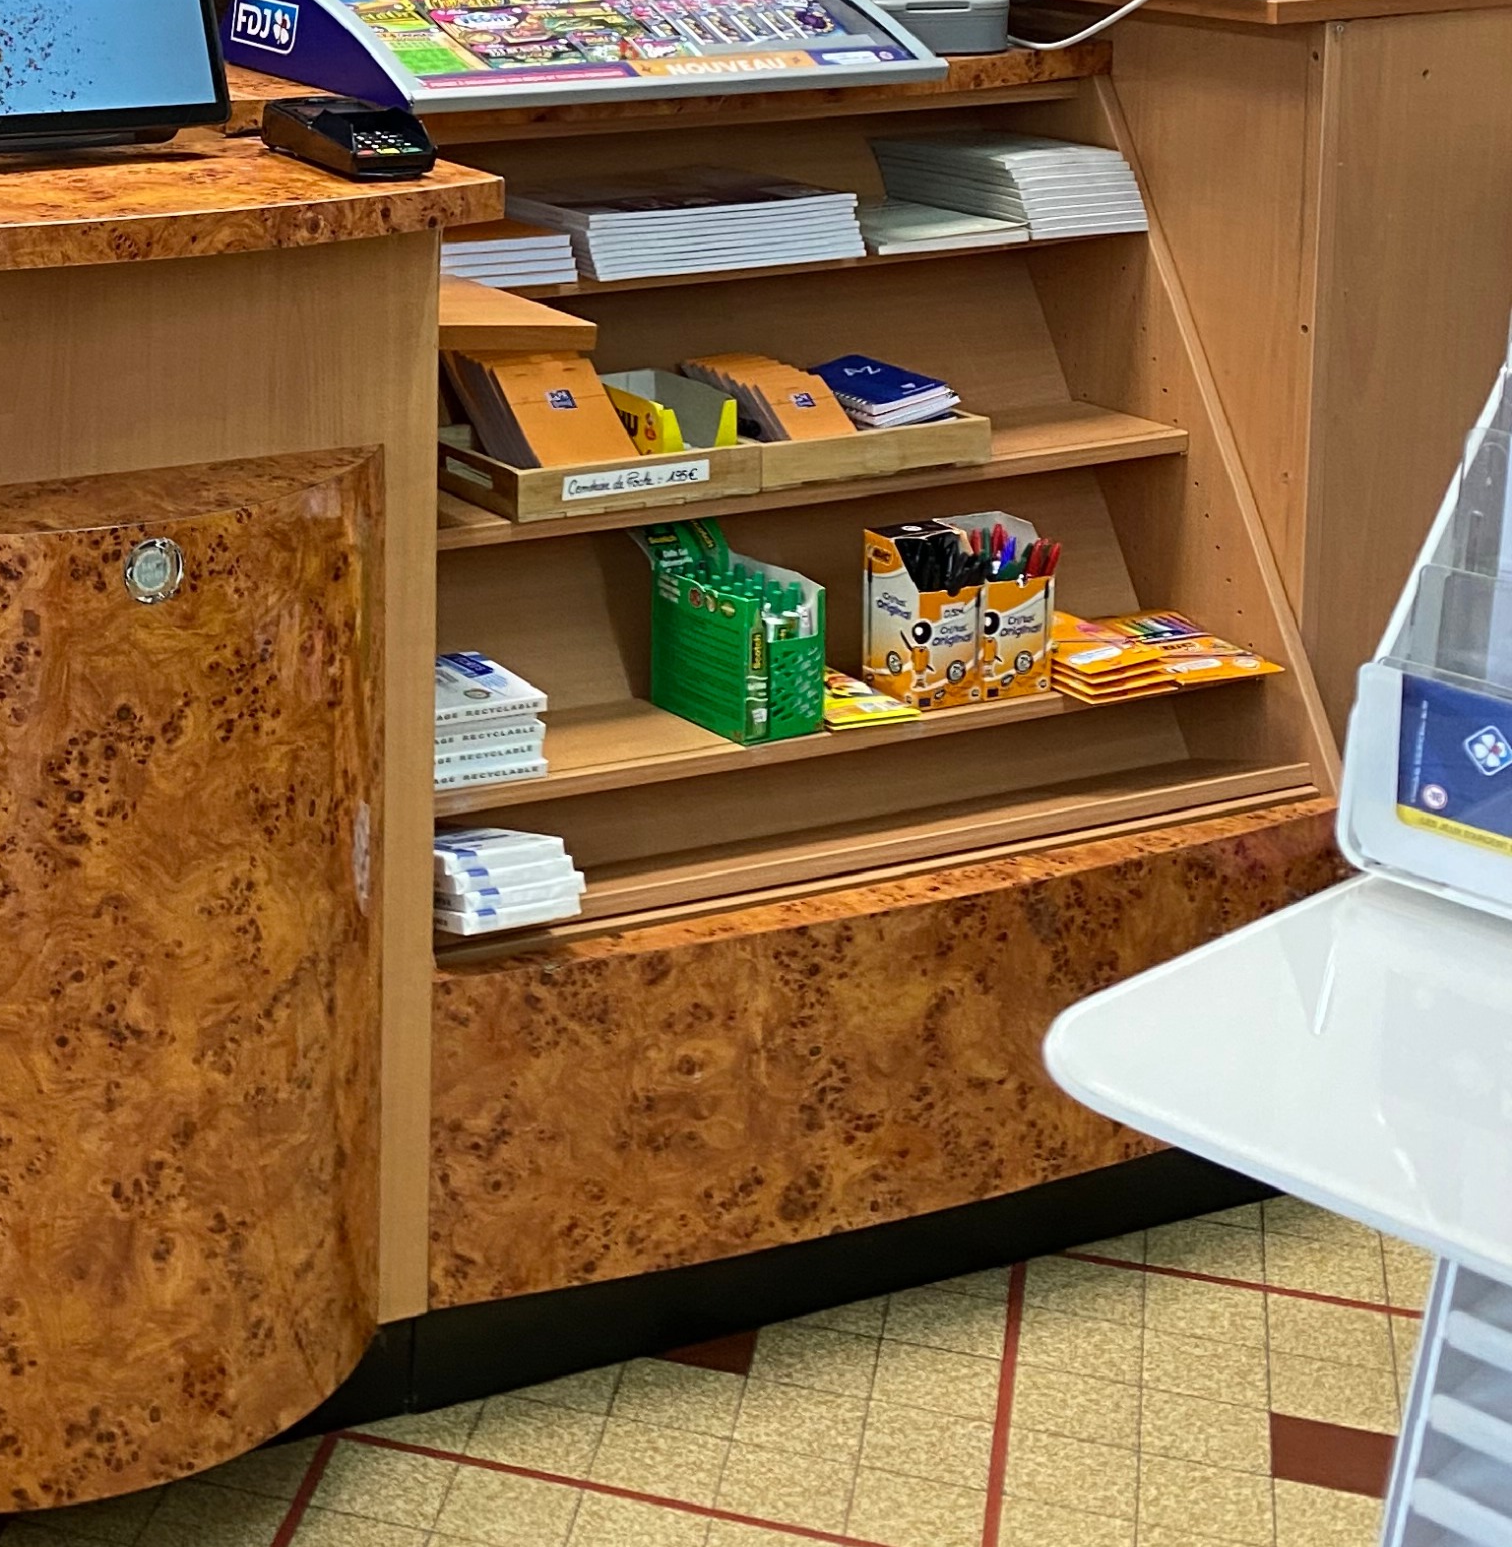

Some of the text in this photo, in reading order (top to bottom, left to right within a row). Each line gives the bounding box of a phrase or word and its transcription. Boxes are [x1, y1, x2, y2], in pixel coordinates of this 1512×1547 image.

[237, 4, 271, 39] FDJ
[668, 57, 786, 77] NOUVEAU
[752, 633, 764, 670] Scotch
[465, 701, 539, 717] RECYCLABLE
[463, 726, 535, 741] RECYCLABLE
[459, 745, 533, 761] RECYCLABLE
[463, 765, 539, 781] RECYCLABLE
